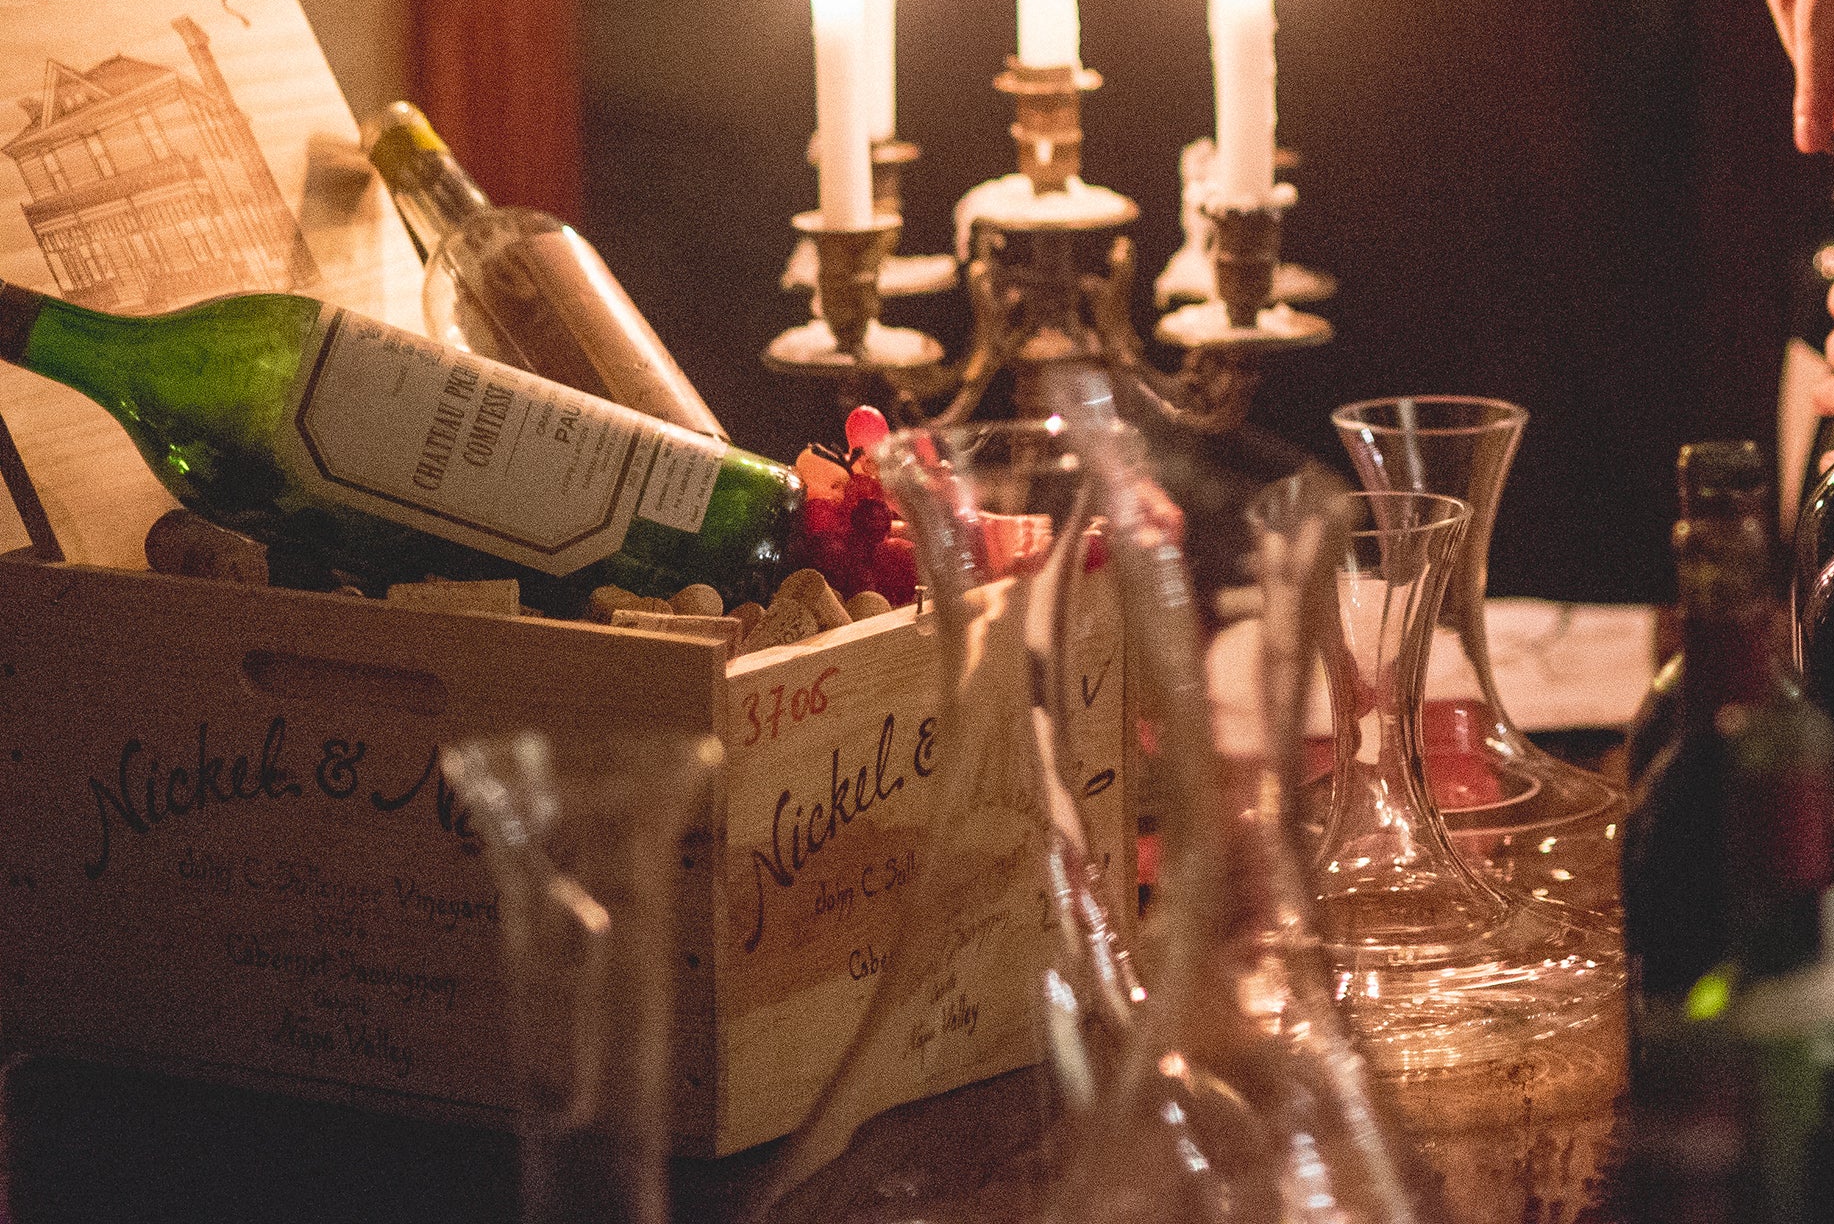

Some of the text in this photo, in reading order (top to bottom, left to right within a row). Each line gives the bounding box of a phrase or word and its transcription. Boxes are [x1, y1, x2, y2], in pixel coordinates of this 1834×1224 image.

[412, 401, 466, 491] CHATEAU
[462, 382, 515, 468] COMTESSE
[742, 666, 840, 747] 3706
[85, 716, 303, 877] Nickel
[315, 738, 367, 799] &
[745, 714, 905, 954] Nickel
